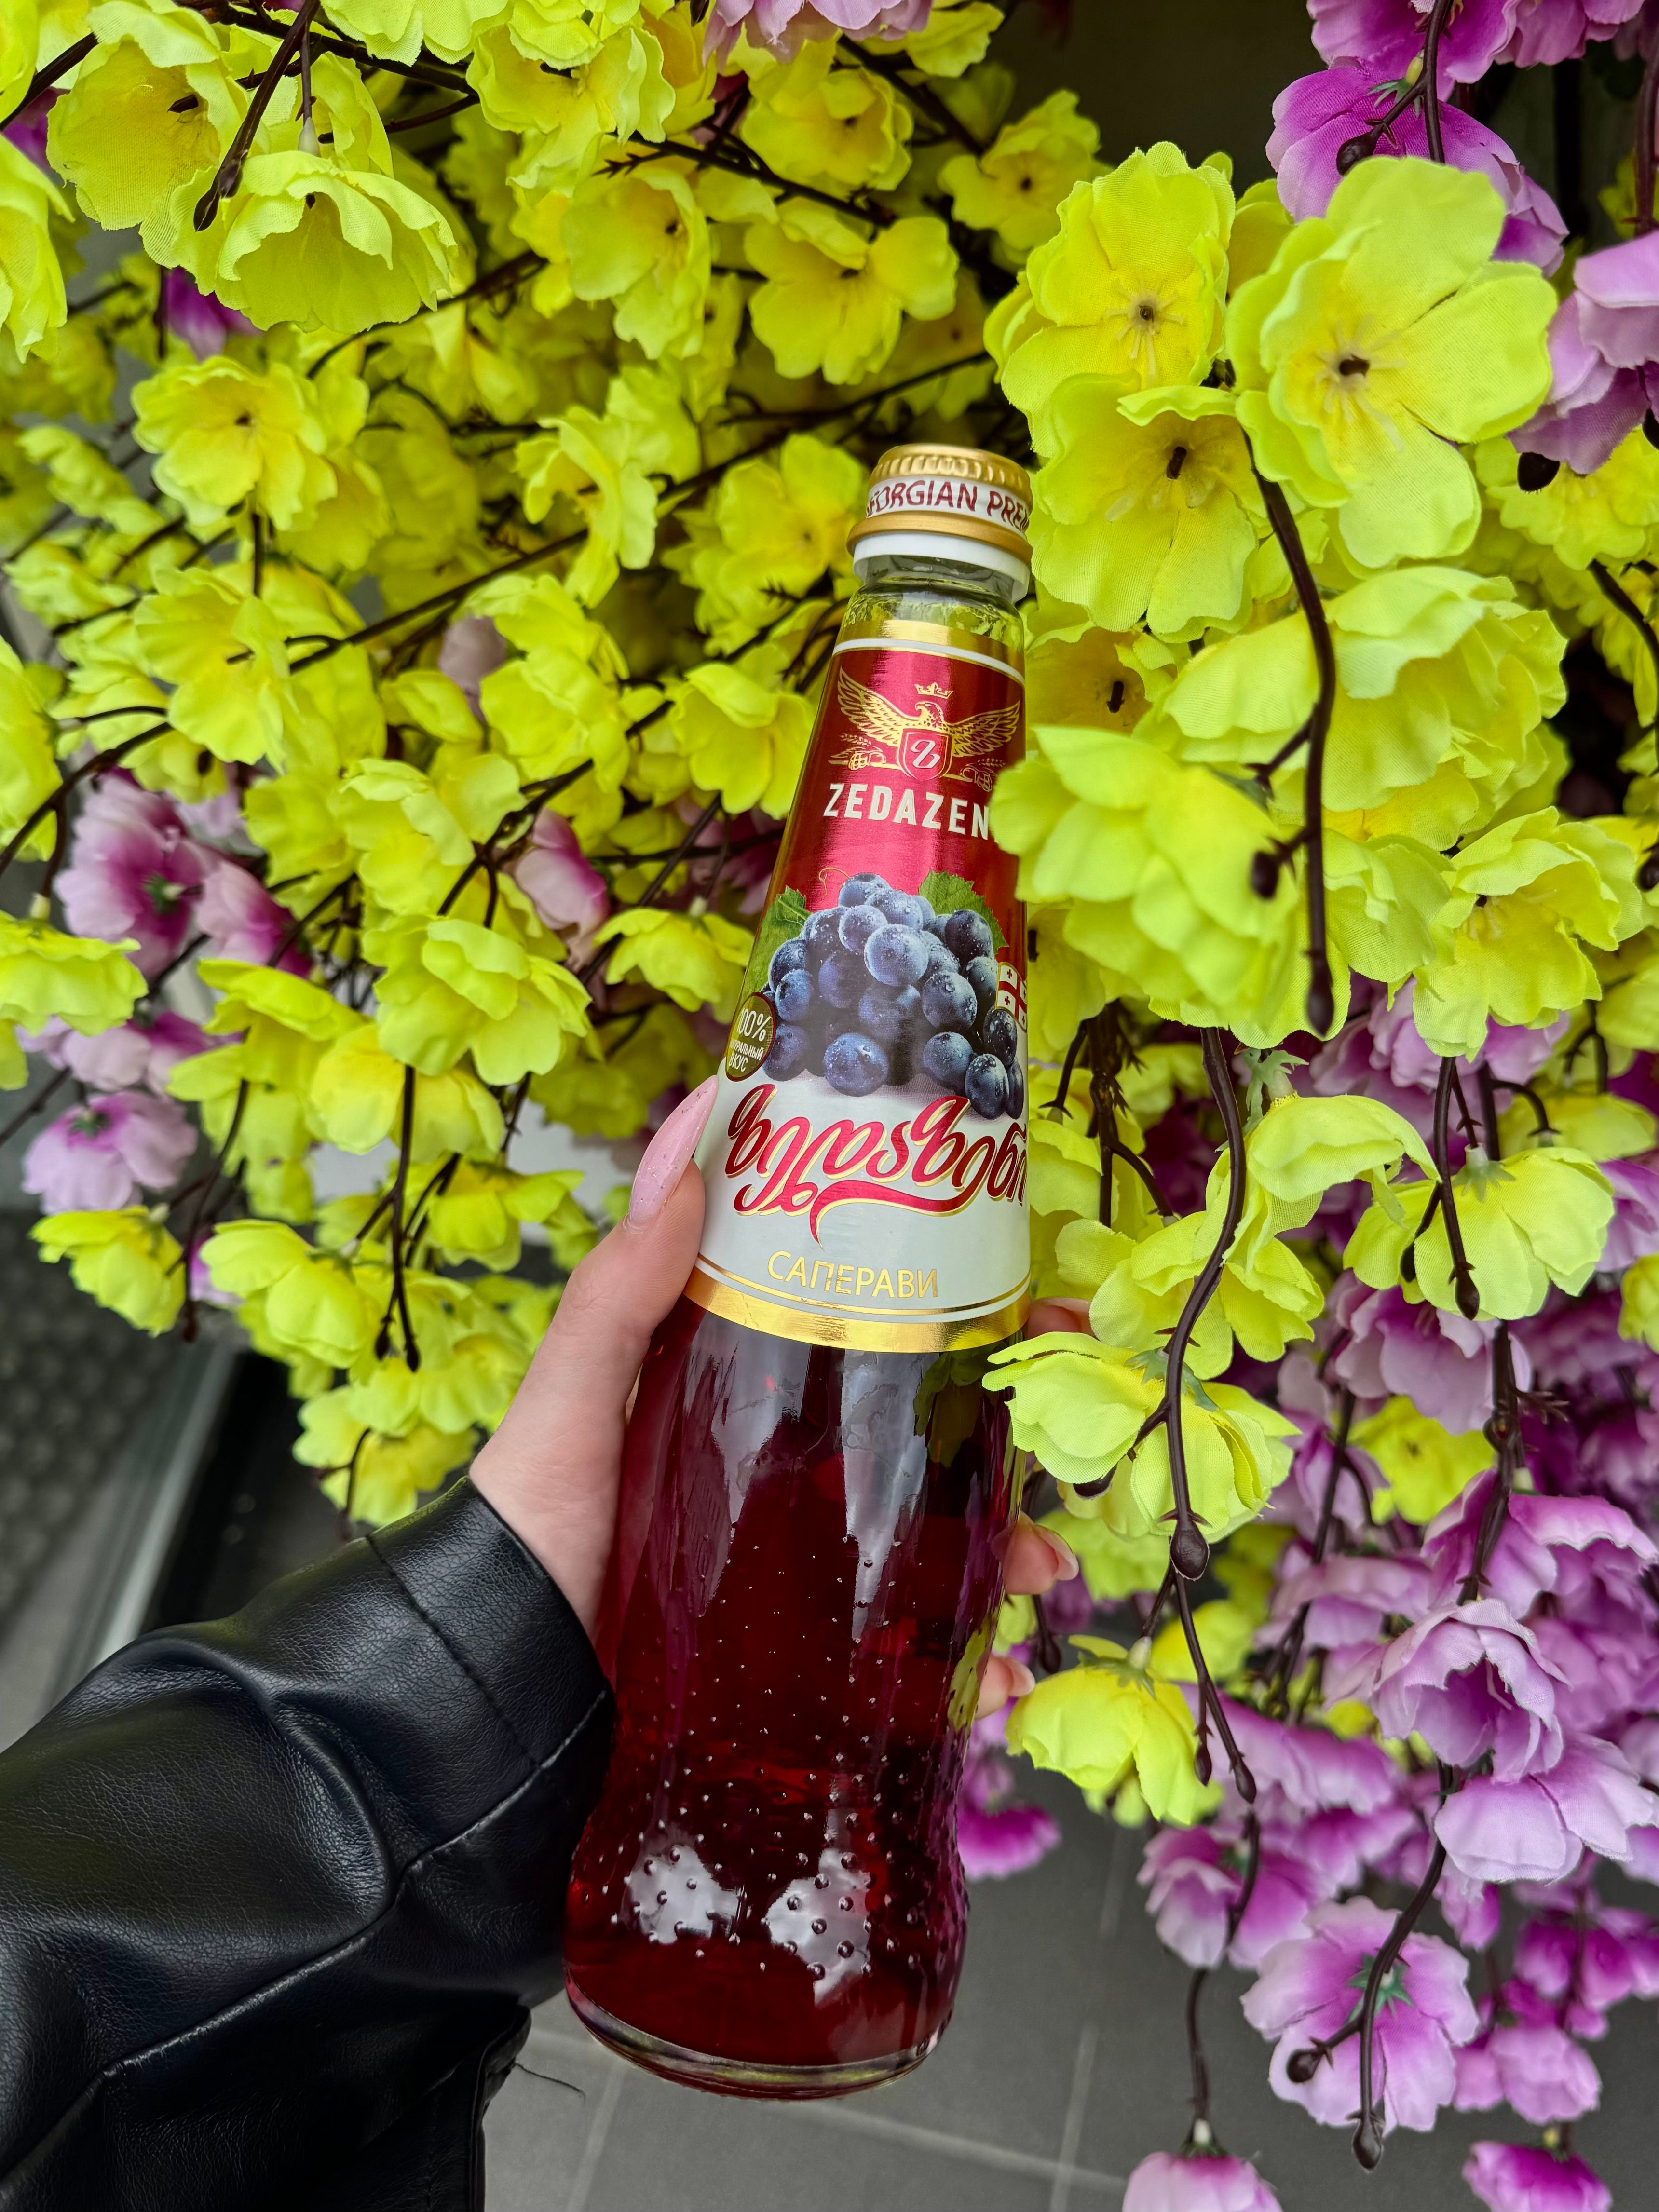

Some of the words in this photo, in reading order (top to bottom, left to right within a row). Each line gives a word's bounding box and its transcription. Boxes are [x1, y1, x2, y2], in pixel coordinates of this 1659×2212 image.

[866, 480, 977, 517] EORGIAN
[823, 783, 992, 841] ZEDAZEN
[729, 1052, 748, 1072] ВКУС
[768, 1251, 938, 1298] САПЕРАВИ
